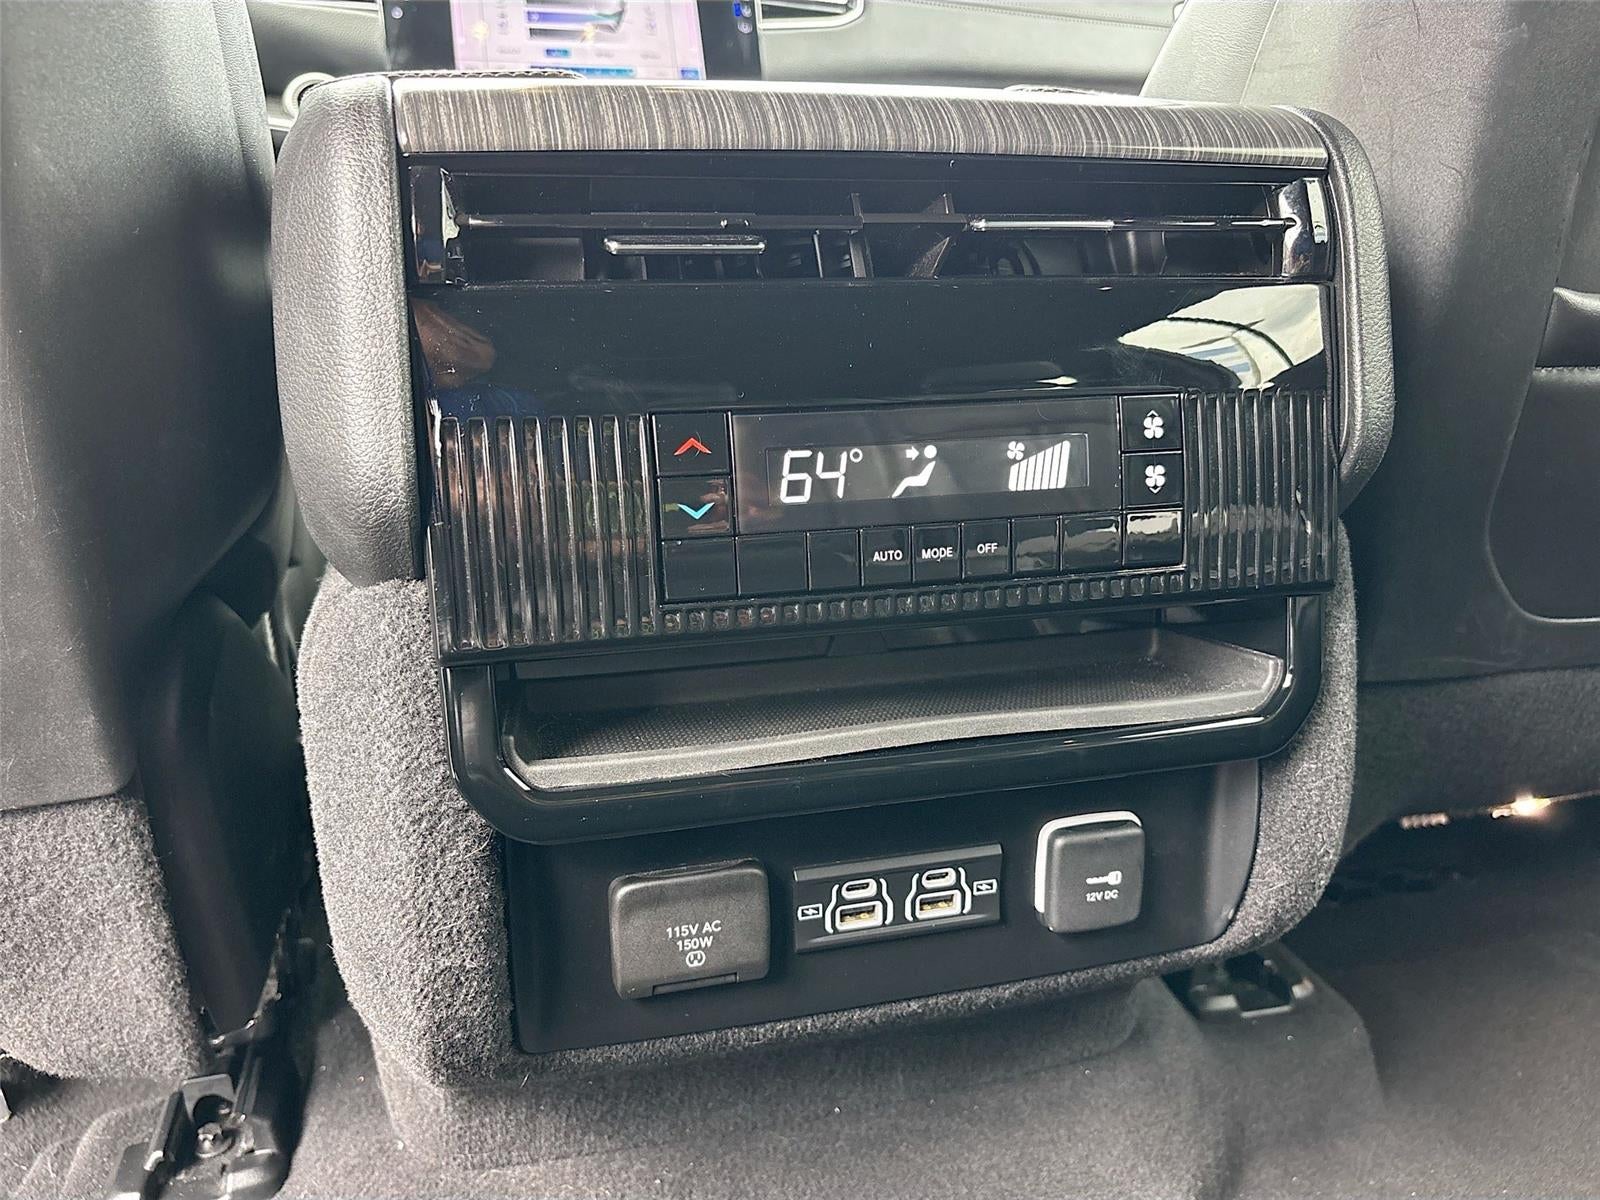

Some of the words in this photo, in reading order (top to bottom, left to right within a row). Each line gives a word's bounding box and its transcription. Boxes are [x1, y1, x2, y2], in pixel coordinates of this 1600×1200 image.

[921, 546, 953, 560] MODE
[976, 542, 998, 554] OFF
[872, 549, 903, 562] AUTO
[1085, 891, 1104, 902] 12V
[1104, 889, 1119, 900] DC
[666, 923, 699, 938] 115V
[702, 920, 722, 934] AC
[676, 935, 714, 951] 150W
